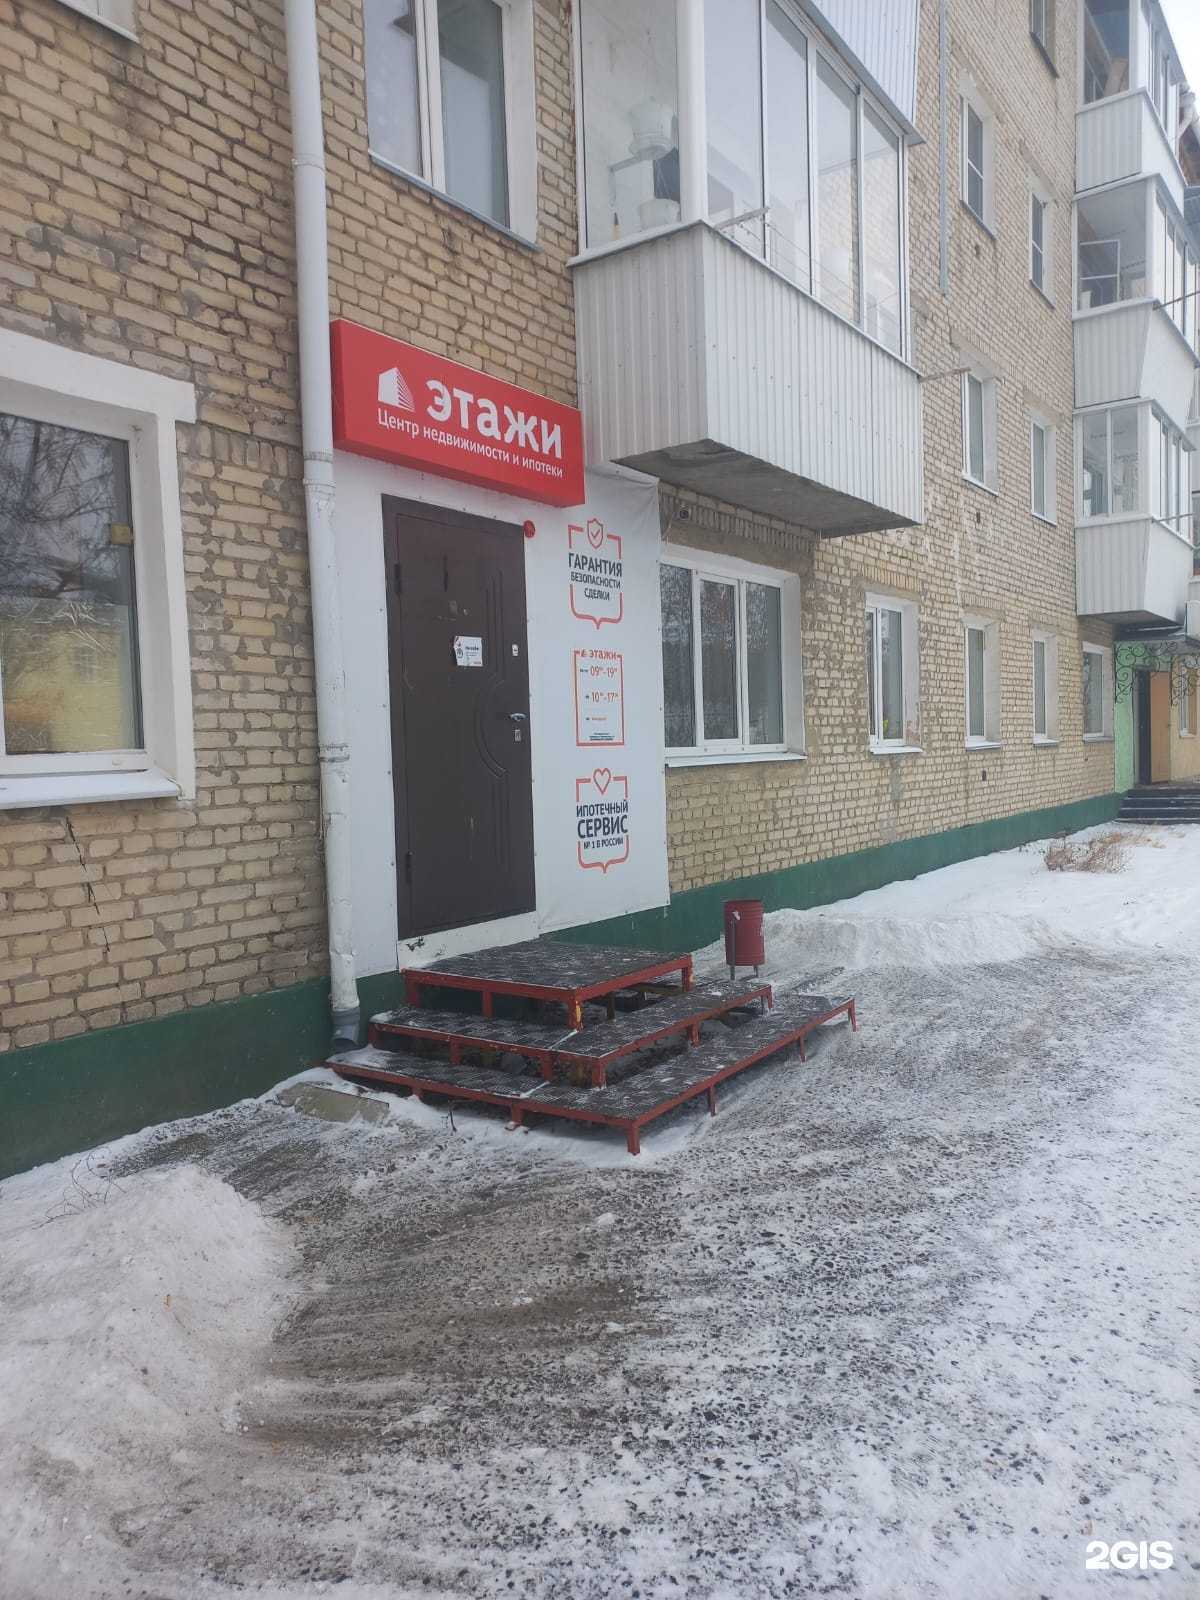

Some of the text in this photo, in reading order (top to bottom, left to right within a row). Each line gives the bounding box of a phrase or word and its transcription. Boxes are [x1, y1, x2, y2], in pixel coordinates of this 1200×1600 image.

[378, 408, 563, 479] Центр недвижимости и ипотеки
[568, 552, 622, 577] ГАРАНТИЯ
[570, 571, 621, 589] БЕЗОПАСНОСТИ
[584, 587, 610, 601] СДЕЛКИ
[576, 799, 628, 817] ИПОТЕЧНЫЙ
[577, 814, 628, 839] СЕРВИС
[601, 837, 624, 848] РОССИИ
